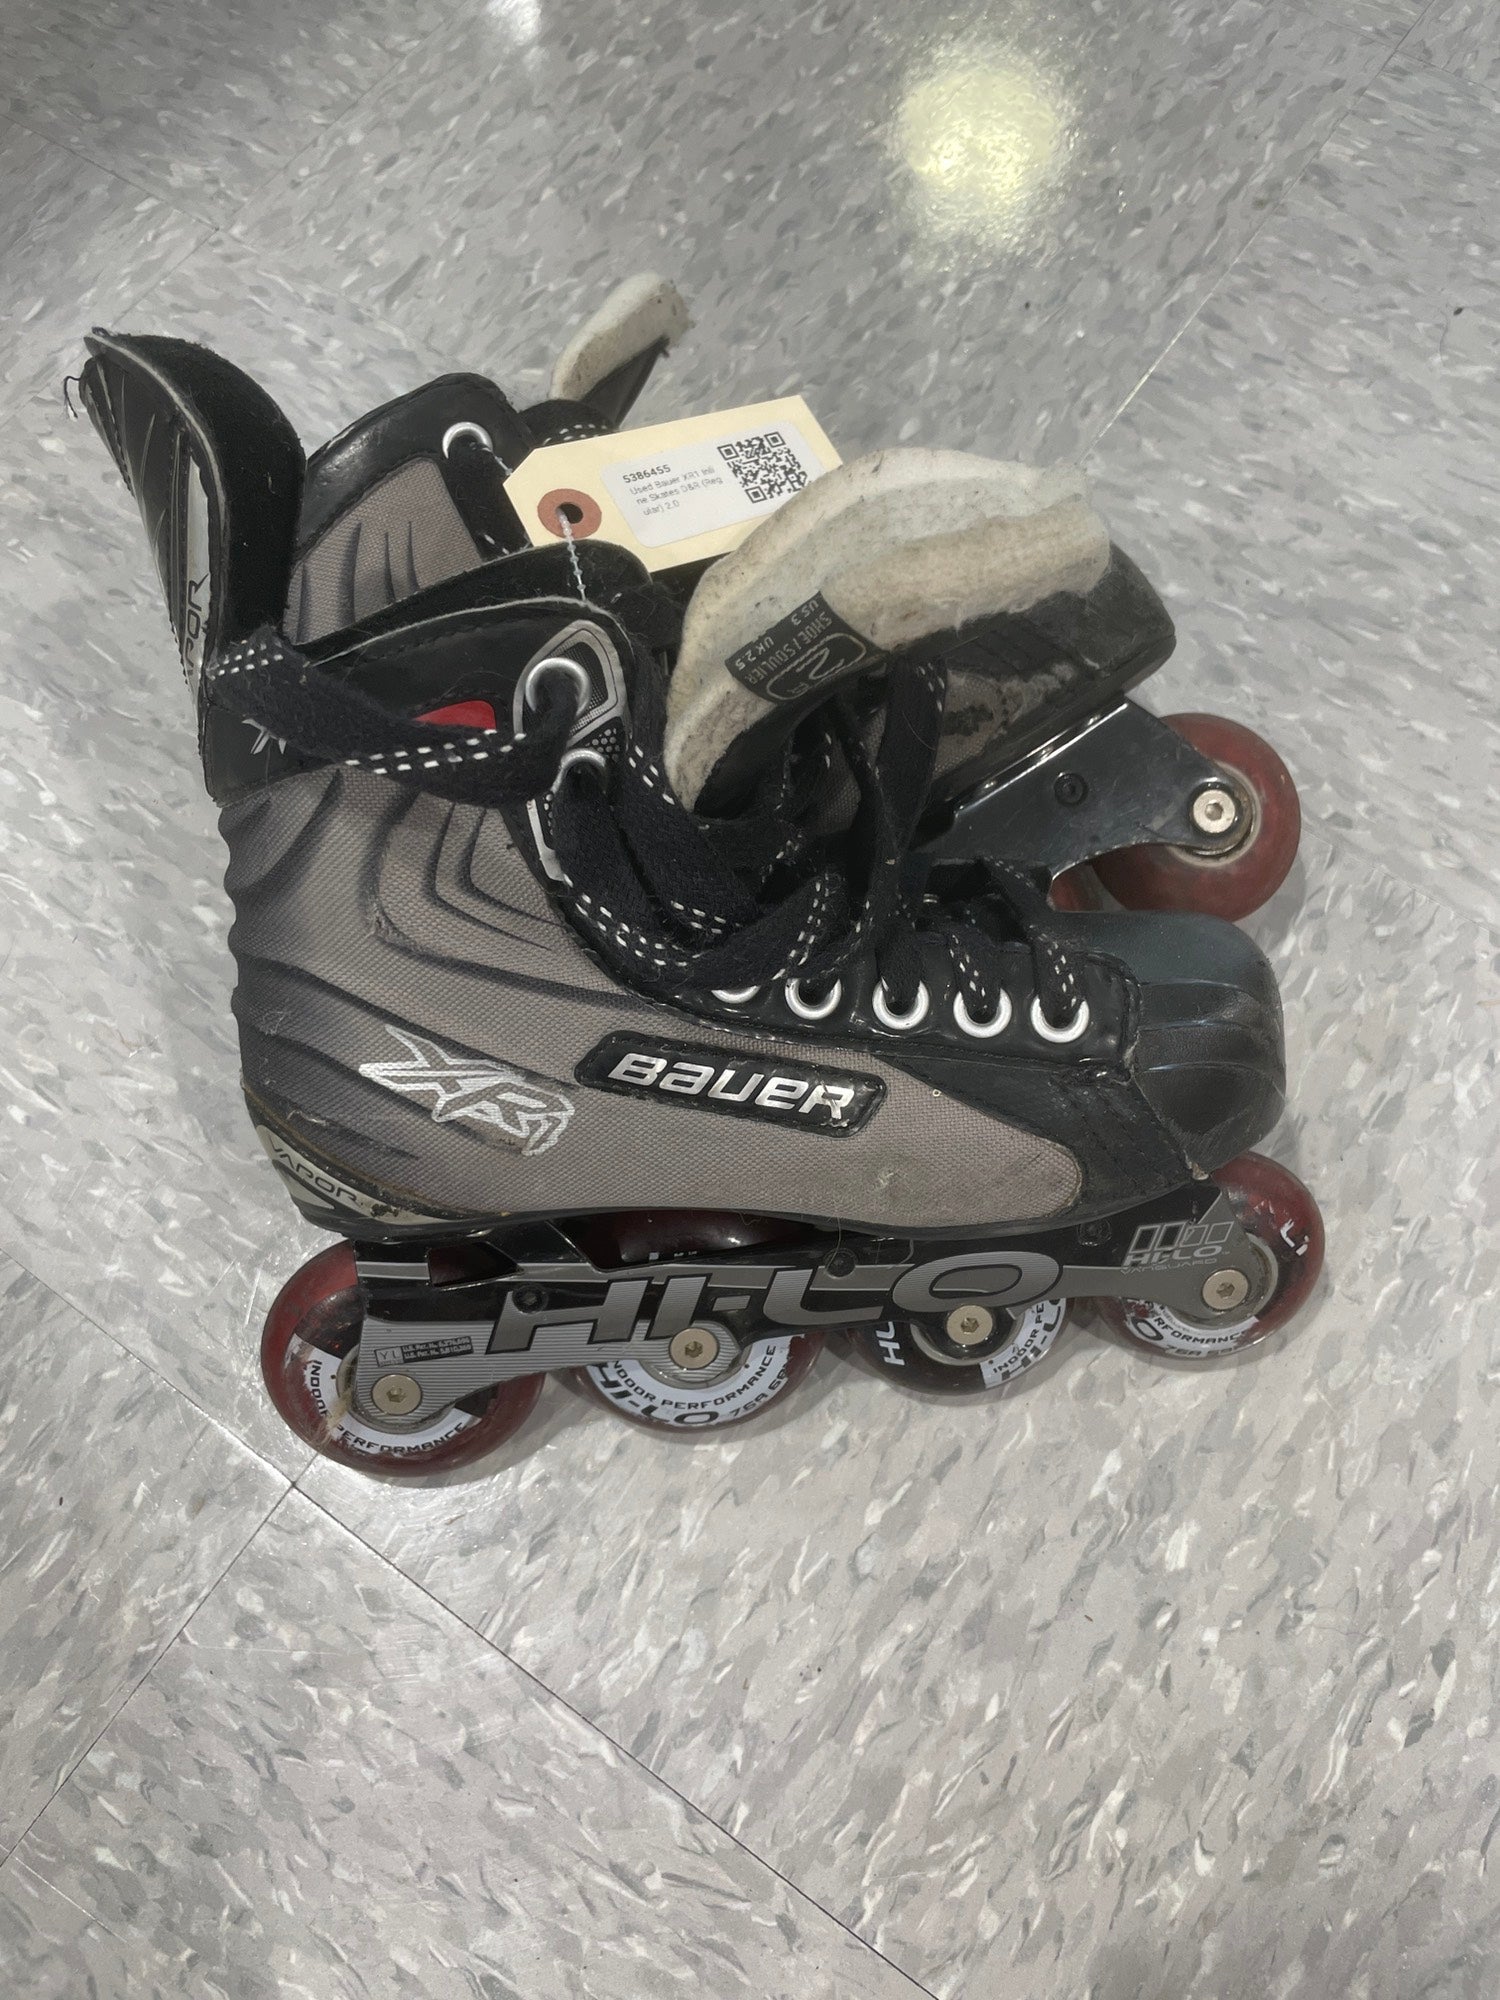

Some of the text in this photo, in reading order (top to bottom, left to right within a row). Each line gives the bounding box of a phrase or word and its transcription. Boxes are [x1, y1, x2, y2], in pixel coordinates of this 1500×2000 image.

[622, 464, 671, 484] 5386455
[629, 482, 655, 497] Used
[656, 476, 680, 489] Bauer
[683, 471, 700, 483] XR1
[636, 496, 648, 506] ne
[648, 488, 679, 502] Skates
[666, 499, 681, 510] 2.0
[735, 599, 820, 671] US 3 UK 2.5
[1122, 1245, 1223, 1267] HI-LO
[485, 1250, 1062, 1355] HI-LO
[992, 1328, 1041, 1374] INDOOR
[613, 1344, 777, 1412] NDOOR PERFORMANCE
[729, 1392, 768, 1418] 76A
